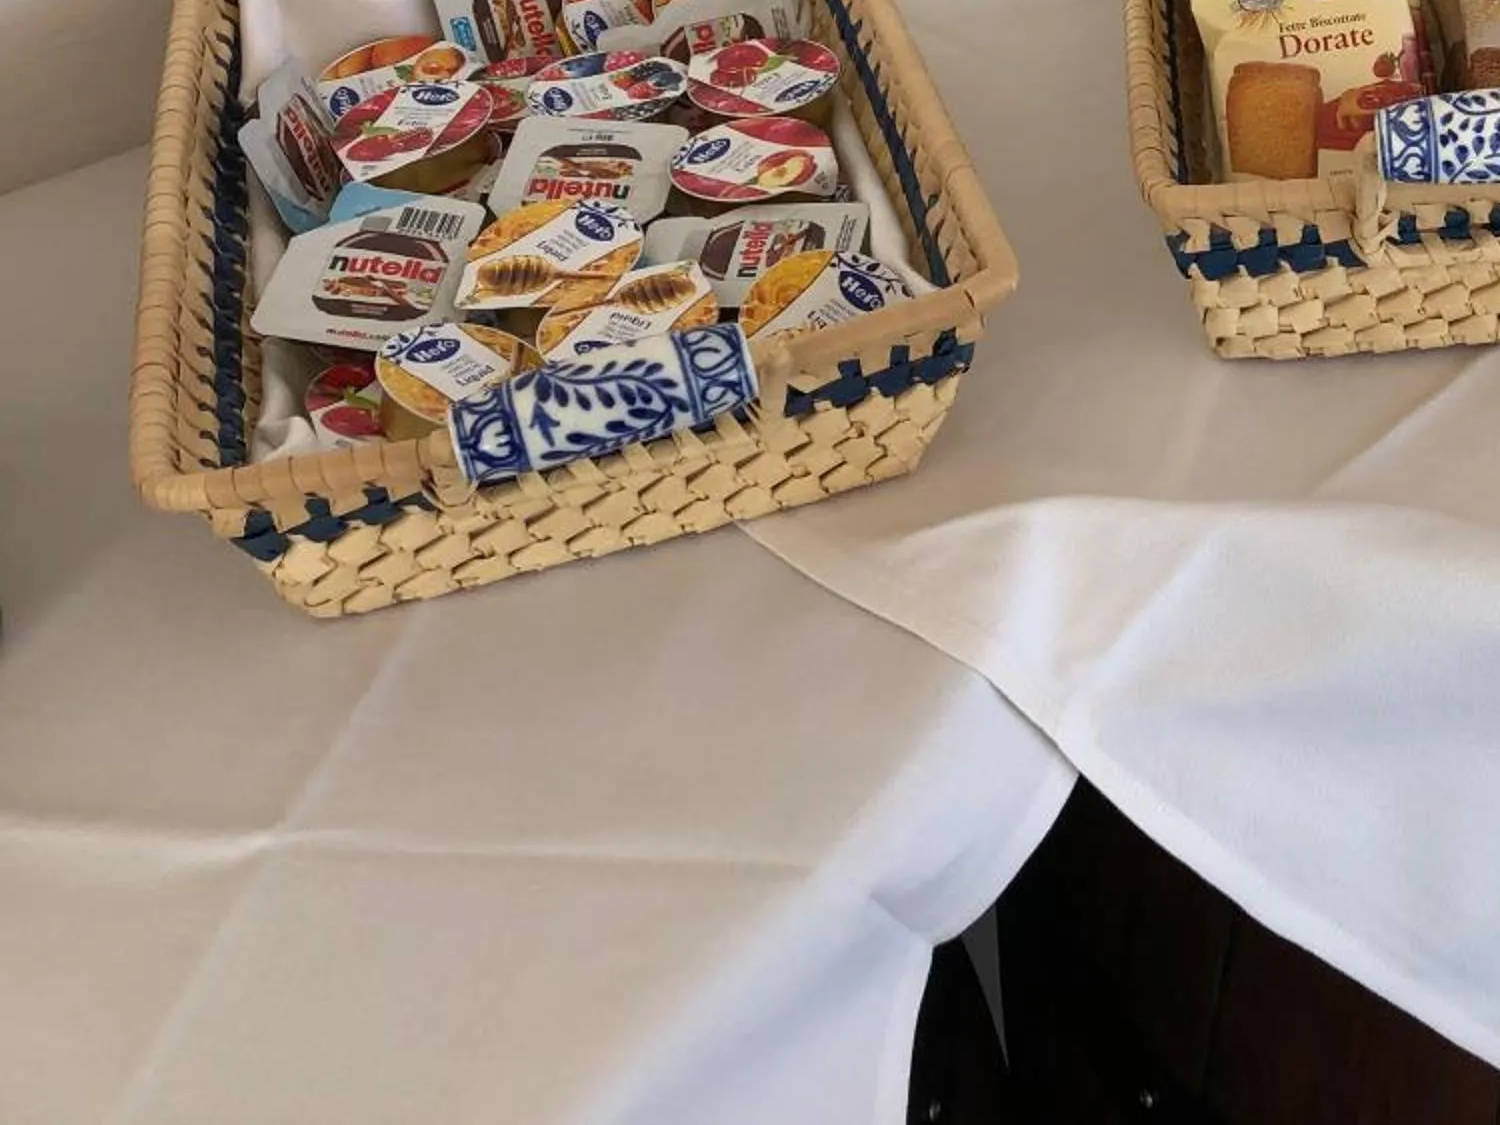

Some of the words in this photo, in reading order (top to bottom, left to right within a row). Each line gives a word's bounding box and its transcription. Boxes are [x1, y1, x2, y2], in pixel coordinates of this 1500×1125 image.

[1279, 26, 1375, 60] Dorate
[415, 87, 459, 104] Hero
[528, 178, 630, 200] nutella
[736, 222, 774, 278] nutella
[328, 255, 442, 284] nutella
[841, 276, 883, 310] Hero
[413, 338, 457, 362] Hero
